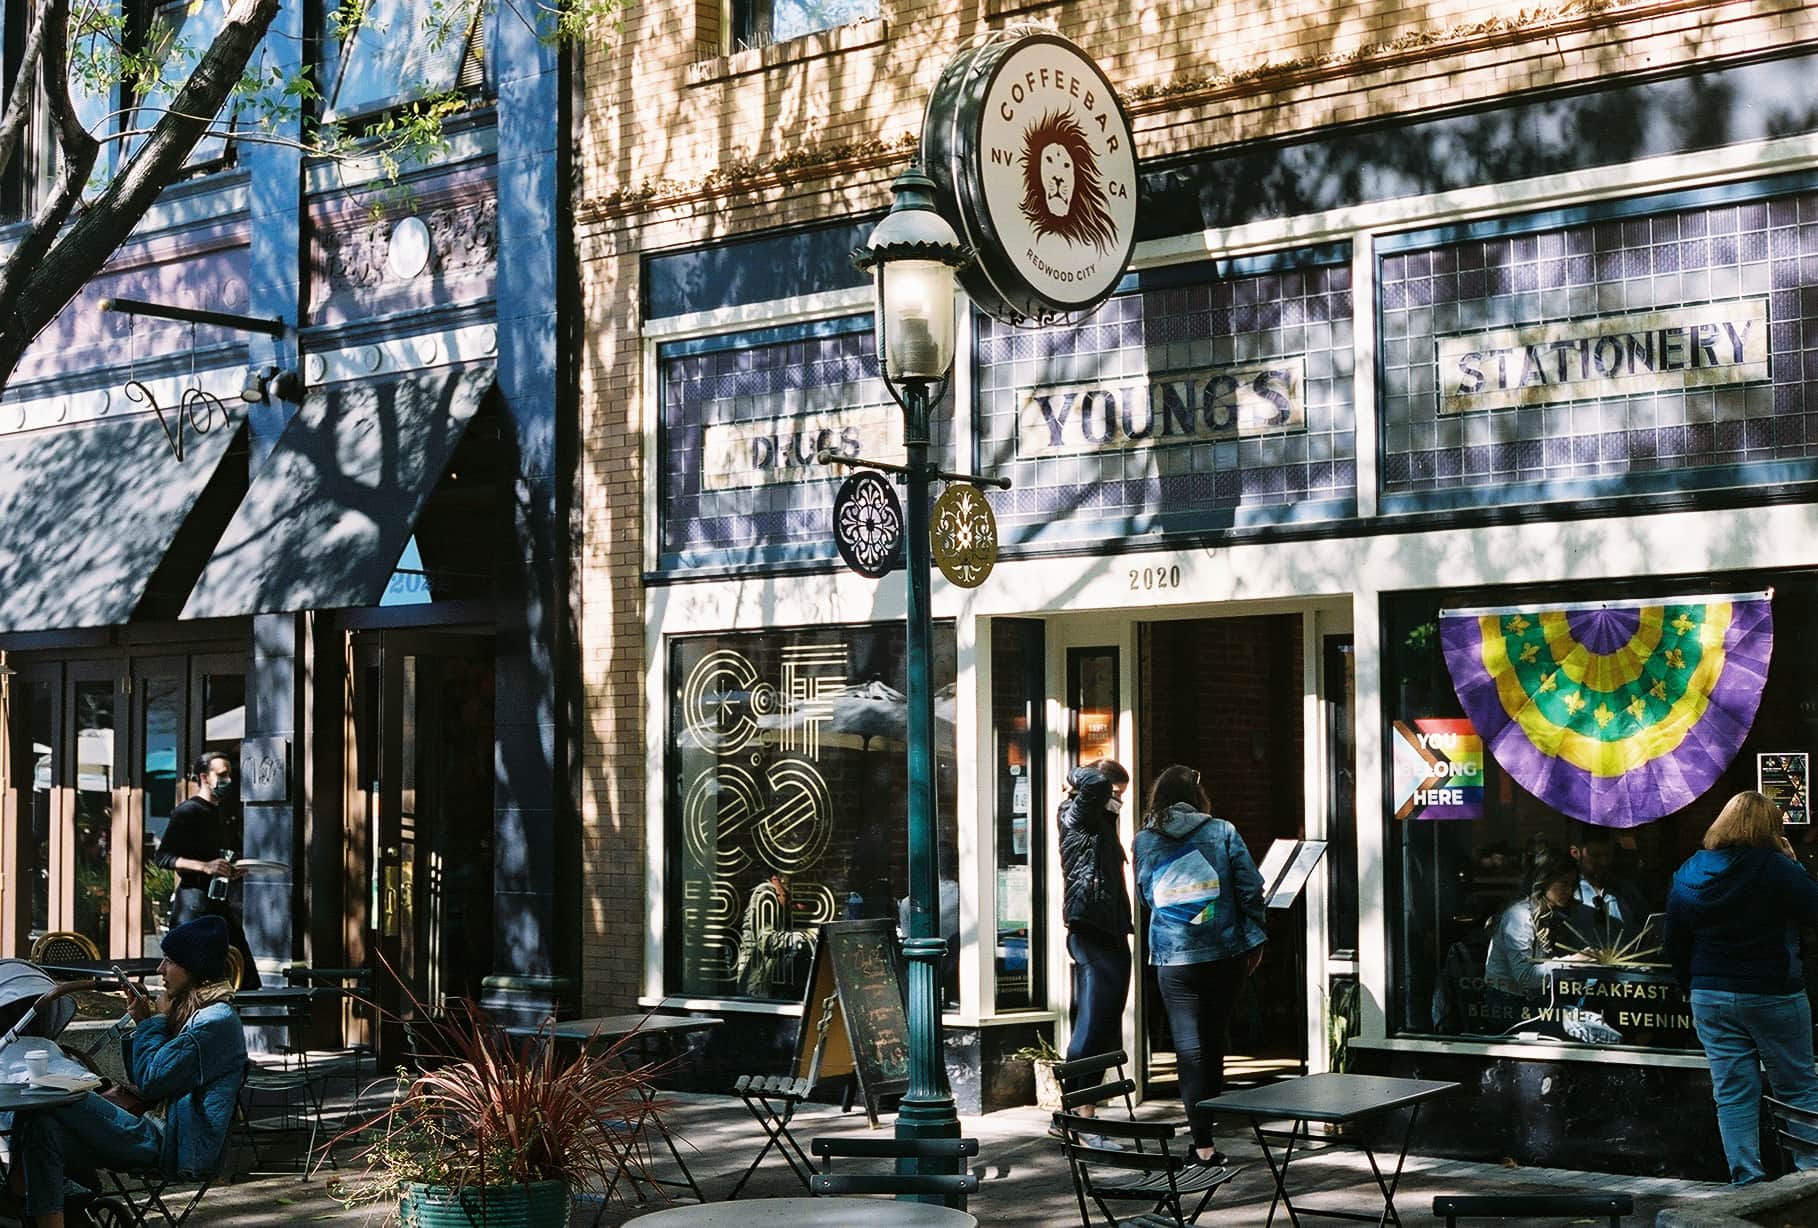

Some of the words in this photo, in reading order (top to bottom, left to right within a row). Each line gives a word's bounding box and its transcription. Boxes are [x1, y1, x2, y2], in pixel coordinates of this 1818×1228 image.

[1000, 68, 1119, 155] COFFEEBAR
[991, 147, 1013, 167] NV
[1108, 181, 1129, 199] CA
[1026, 248, 1074, 283] REDWOOD
[1076, 264, 1097, 281] CITY
[1456, 319, 1753, 396] STATIONERY
[1129, 565, 1181, 591] 2020
[1416, 733, 1457, 749] YOU
[1398, 761, 1477, 777] BELONG
[1414, 789, 1464, 805] HERE
[1560, 980, 1669, 1000] BREAKFAST
[1467, 1003, 1513, 1019] BEER
[1521, 1006, 1531, 1020] &
[1619, 1011, 1690, 1029] EVENIN
